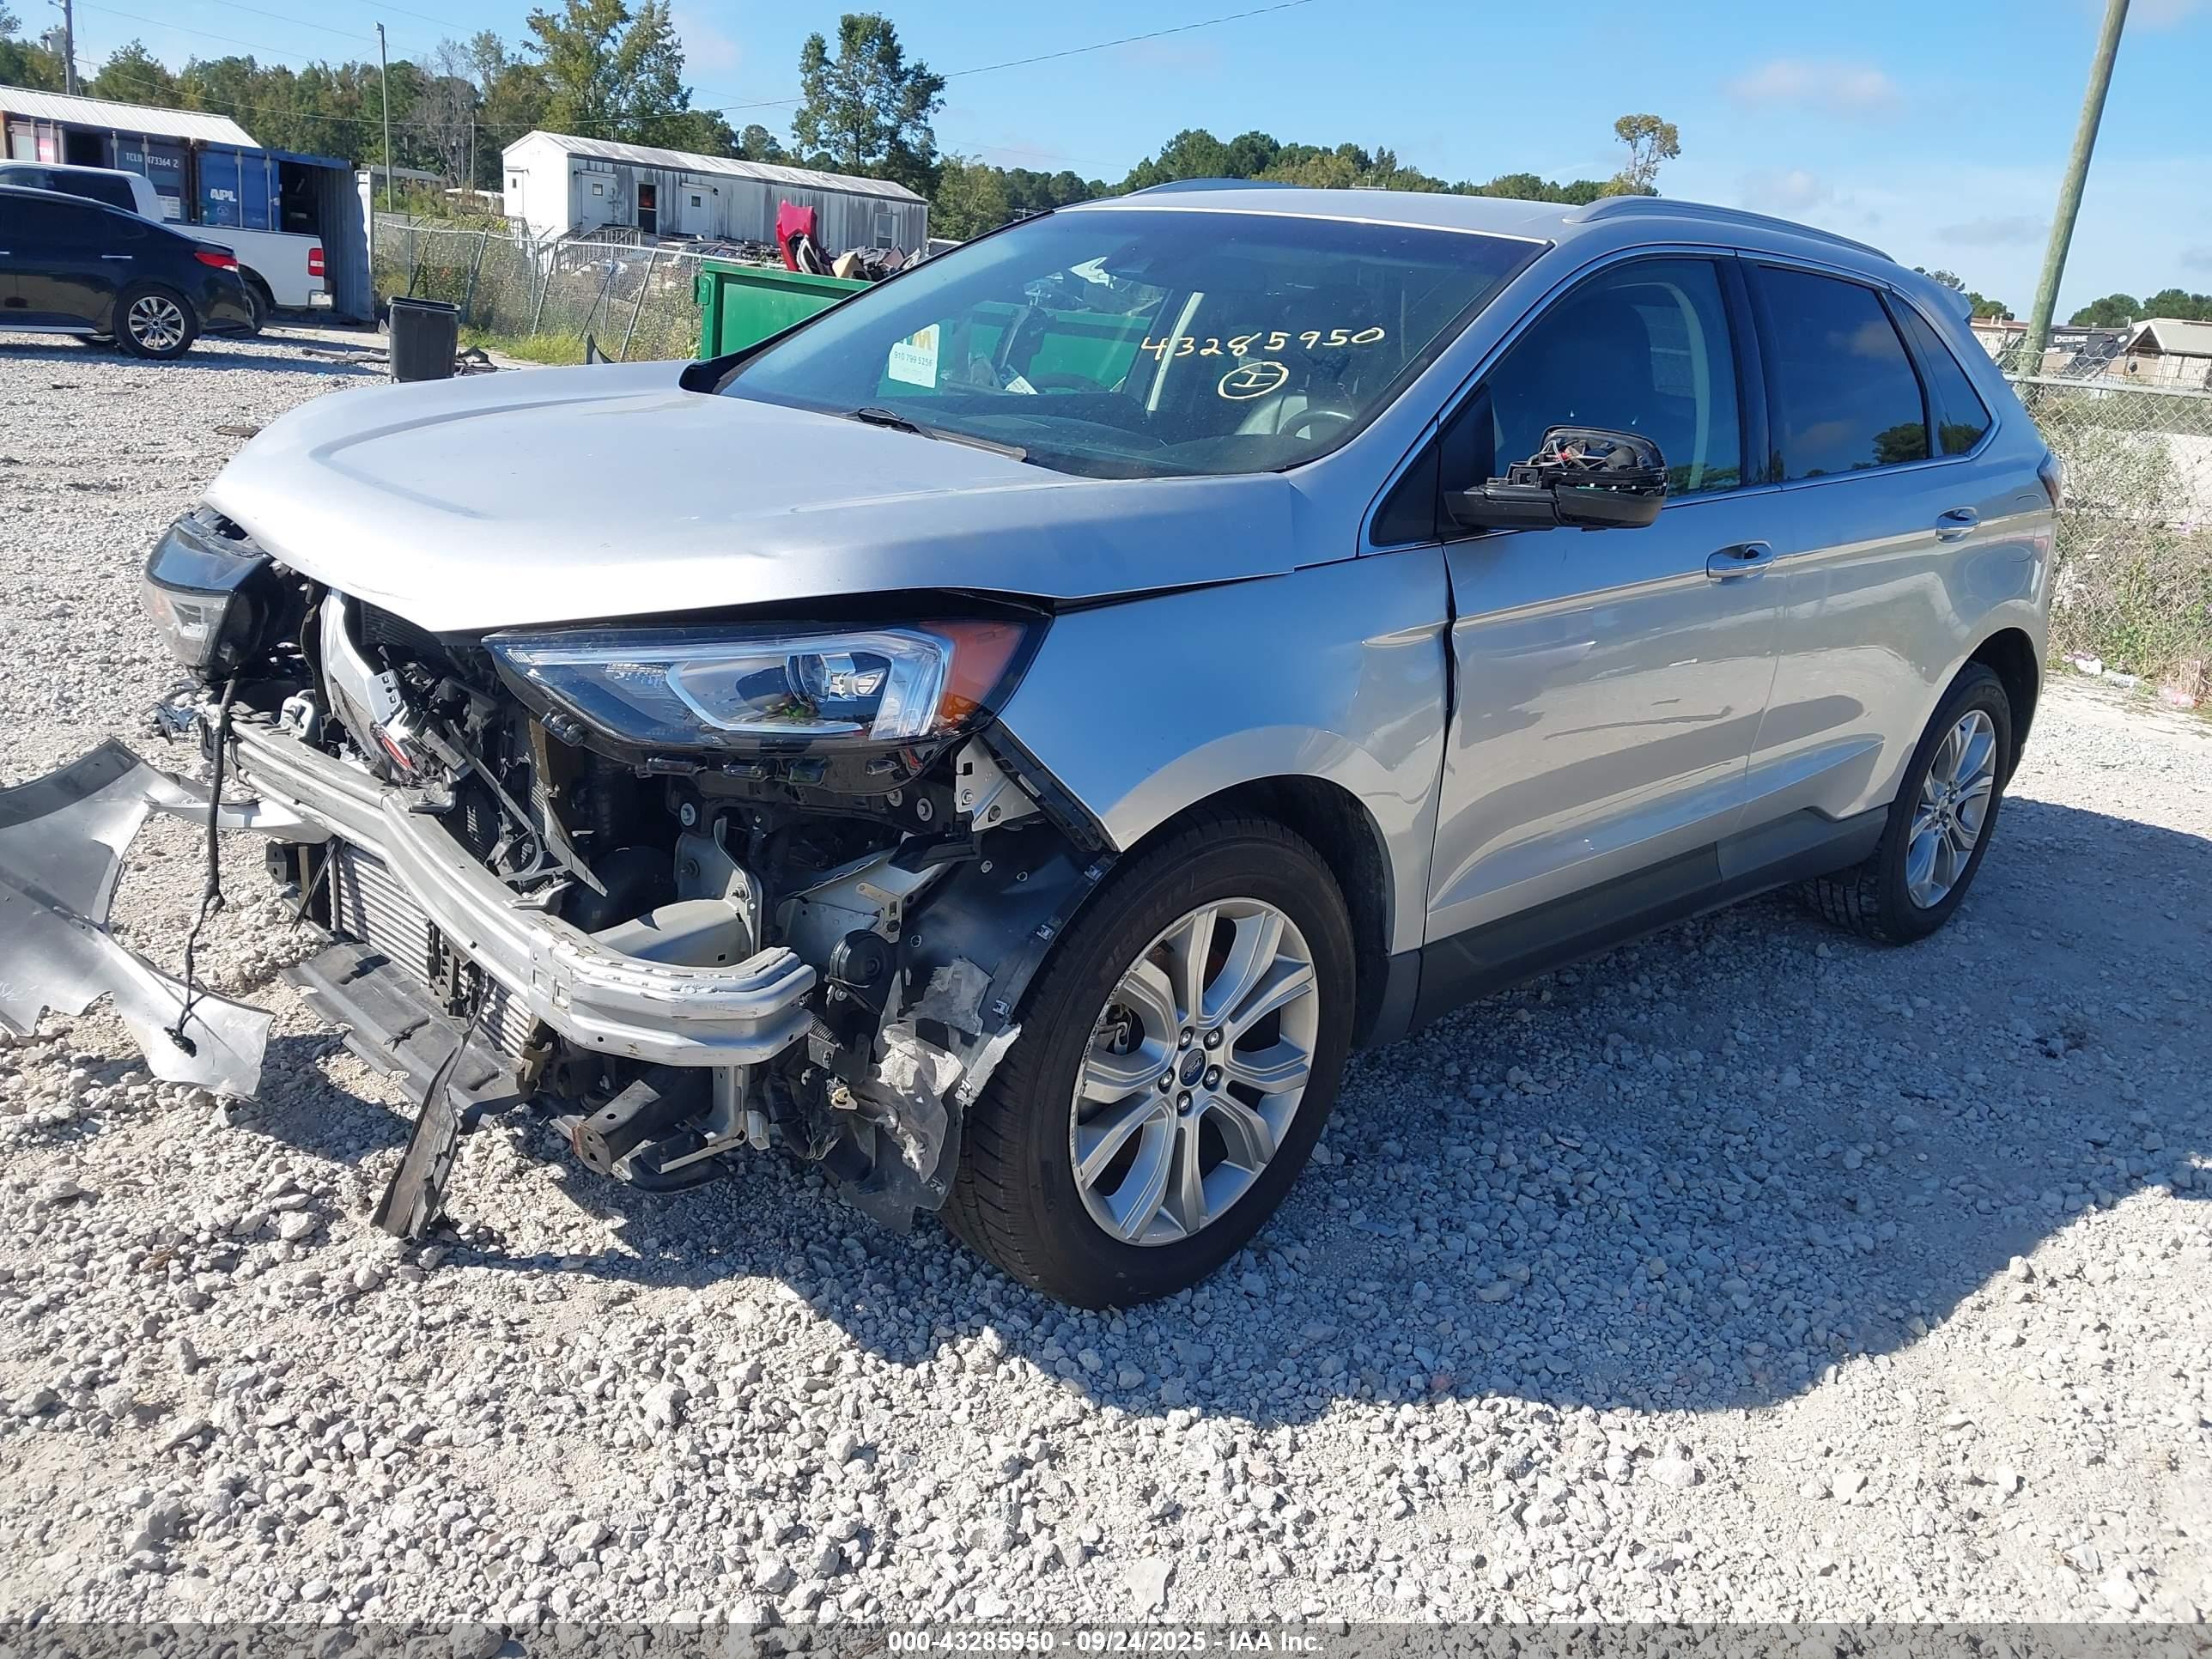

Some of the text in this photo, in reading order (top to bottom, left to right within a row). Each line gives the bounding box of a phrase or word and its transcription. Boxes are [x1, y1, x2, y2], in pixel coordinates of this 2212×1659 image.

[173, 159, 179, 168] 2
[210, 188, 237, 202] APL
[1140, 326, 1386, 361] 43285950
